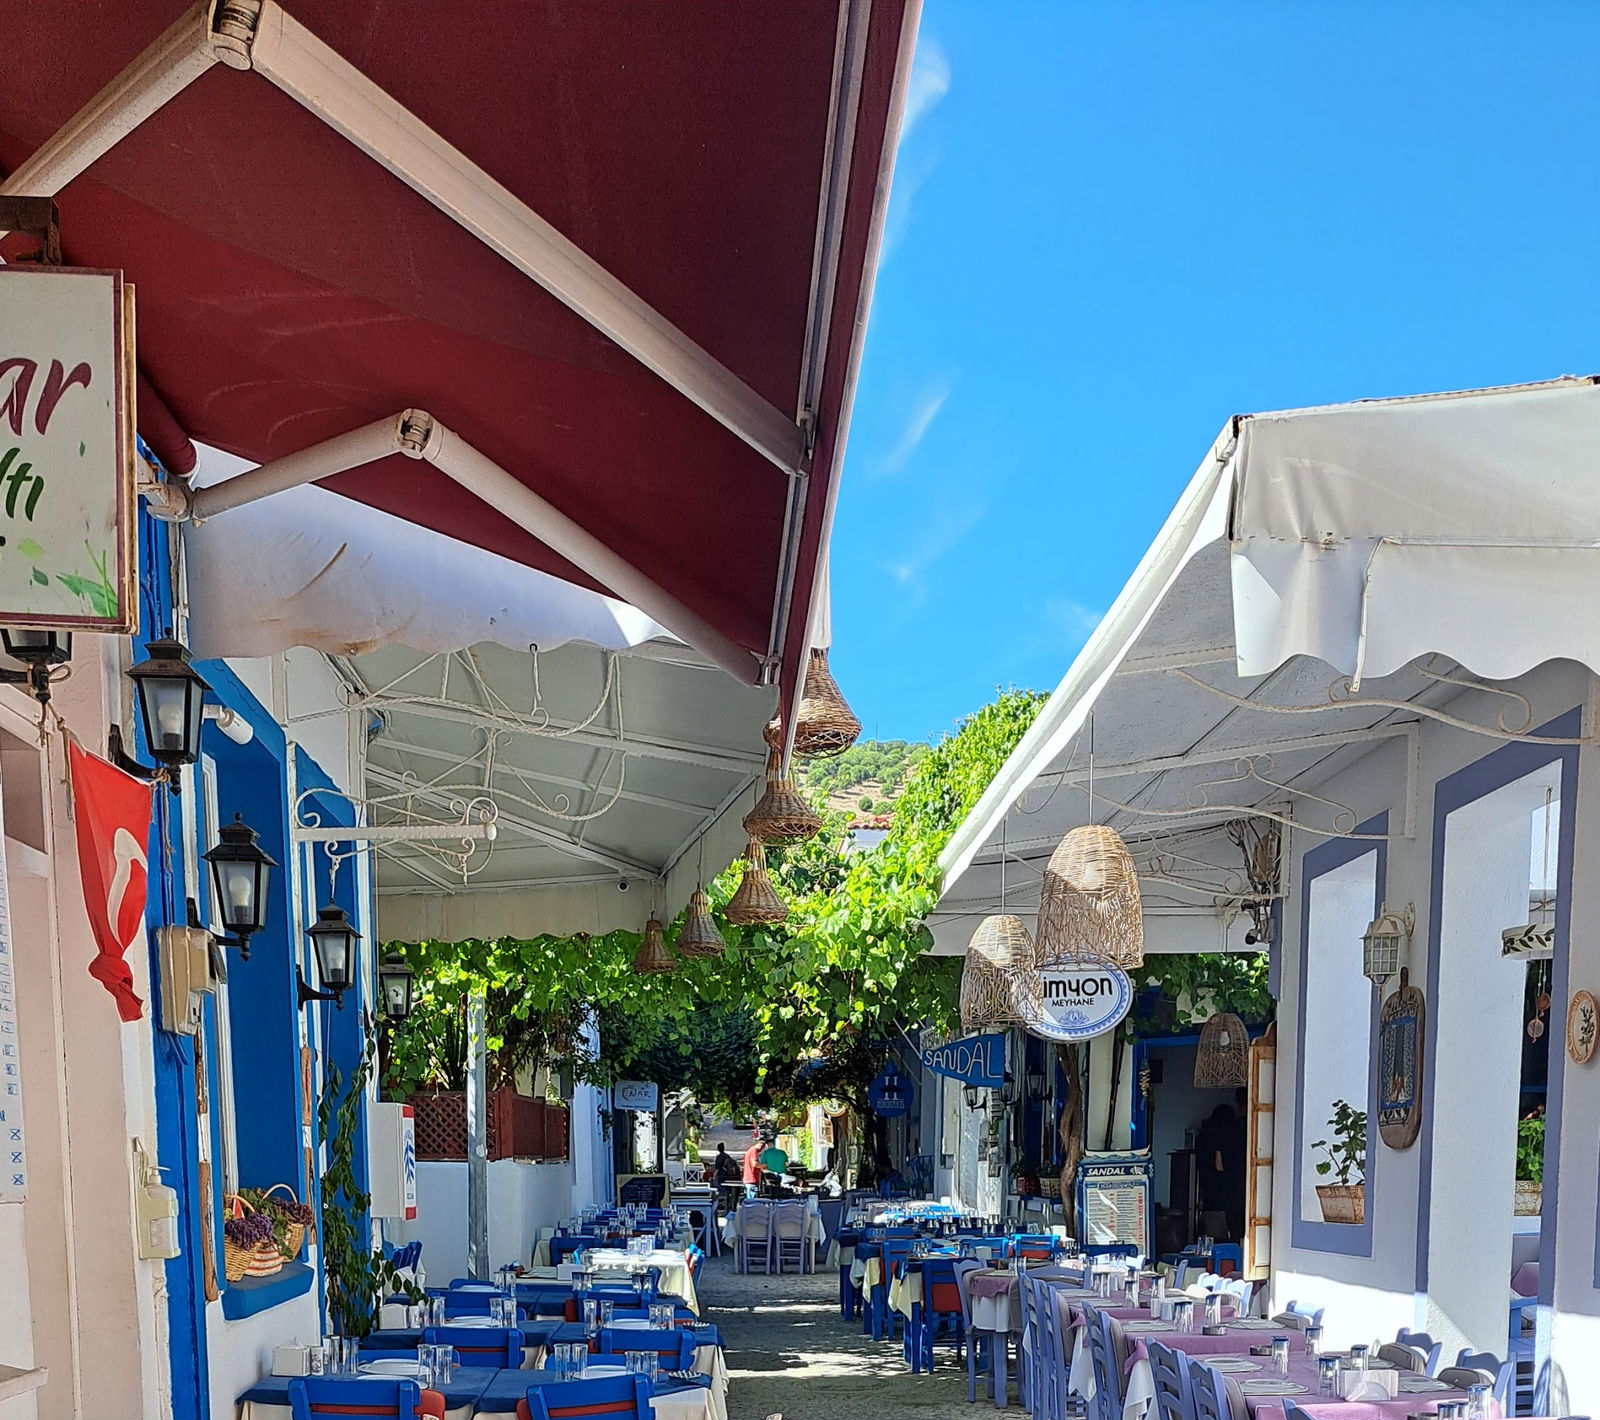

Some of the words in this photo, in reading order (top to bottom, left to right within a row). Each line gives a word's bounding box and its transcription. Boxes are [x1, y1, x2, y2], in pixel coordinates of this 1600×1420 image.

[1043, 976, 1113, 998] imyon
[1051, 998, 1095, 1008] MEYHANE
[924, 1041, 1003, 1078] SANDAL
[1086, 1167, 1126, 1177] SANDAL
